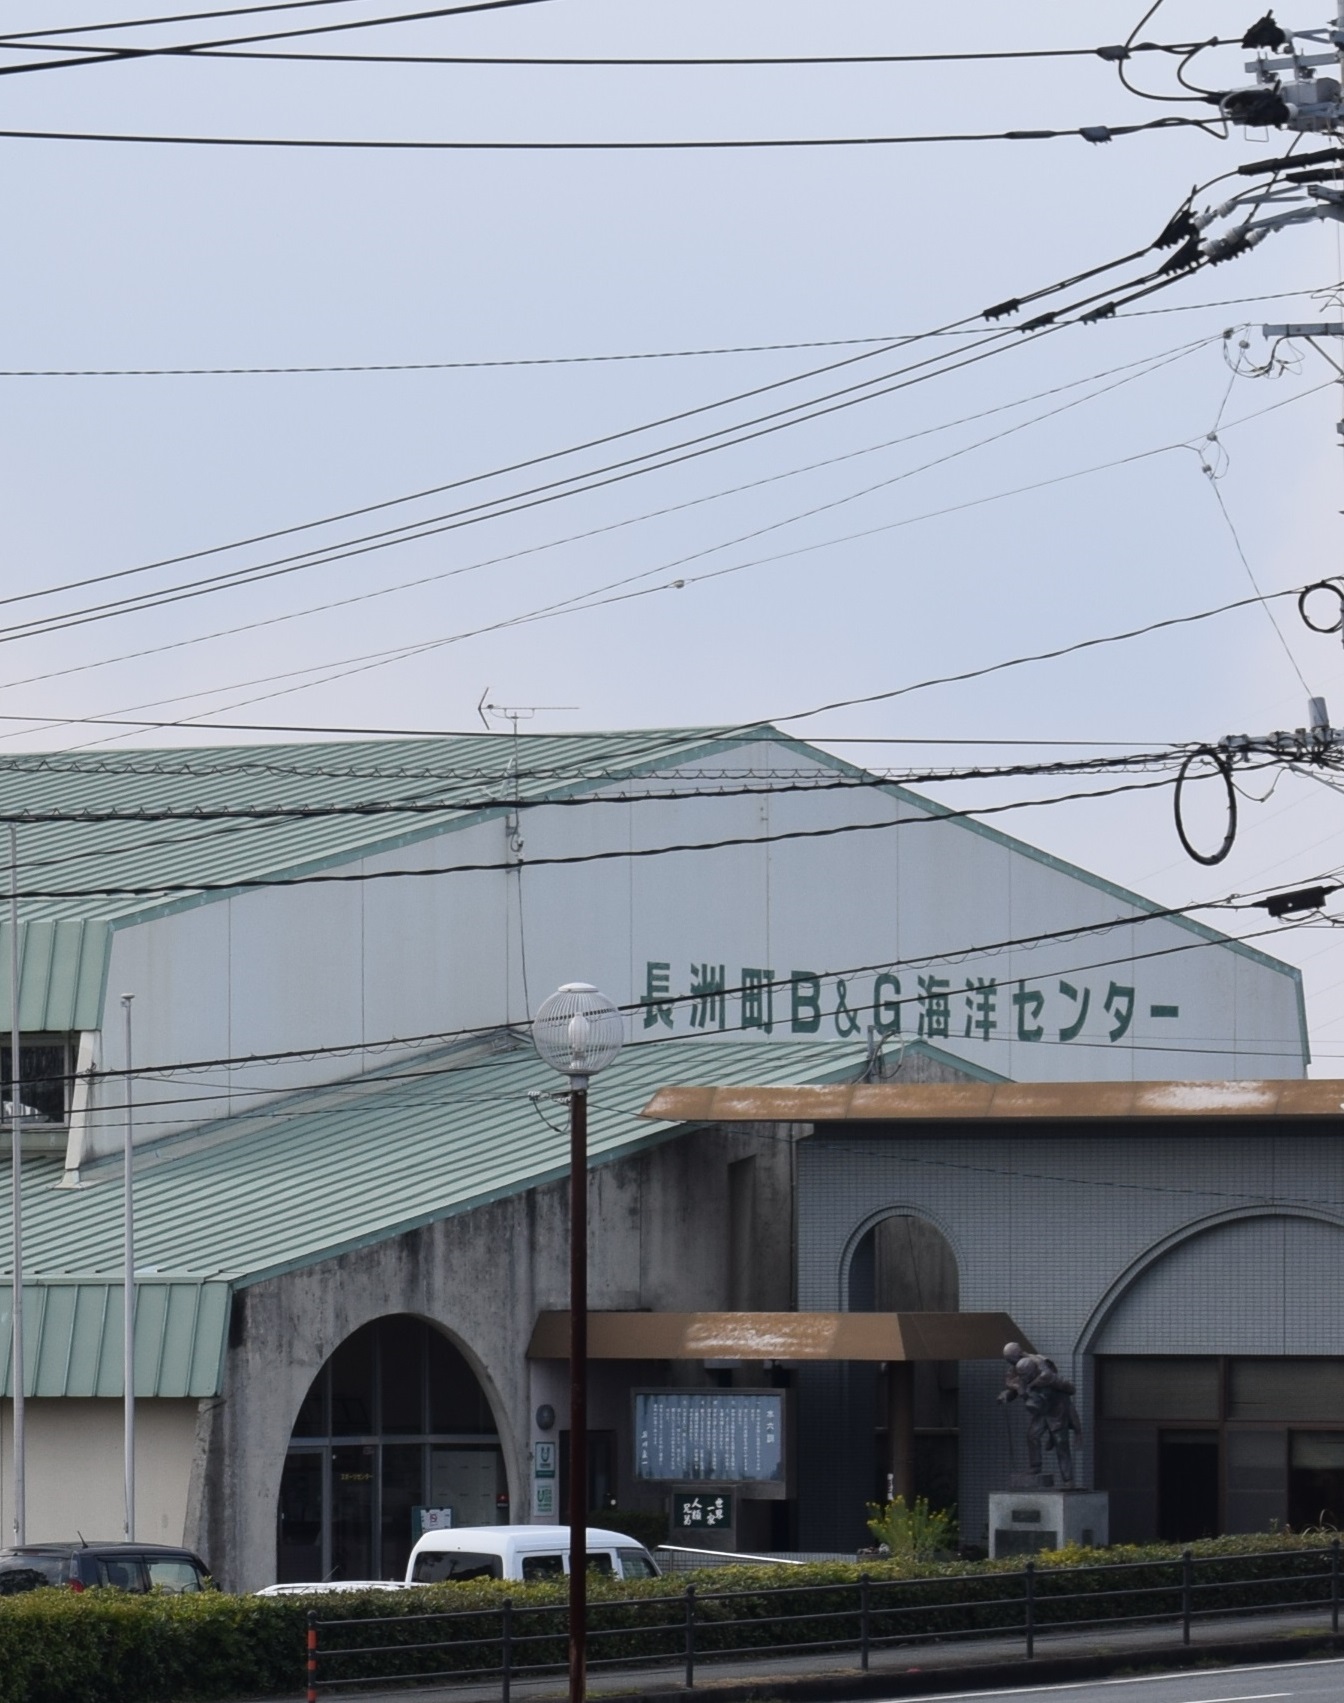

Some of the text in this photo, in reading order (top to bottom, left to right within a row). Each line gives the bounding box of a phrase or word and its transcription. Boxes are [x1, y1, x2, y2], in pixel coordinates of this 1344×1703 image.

[640, 961, 1180, 1043] 長洲町B&G海洋センター
